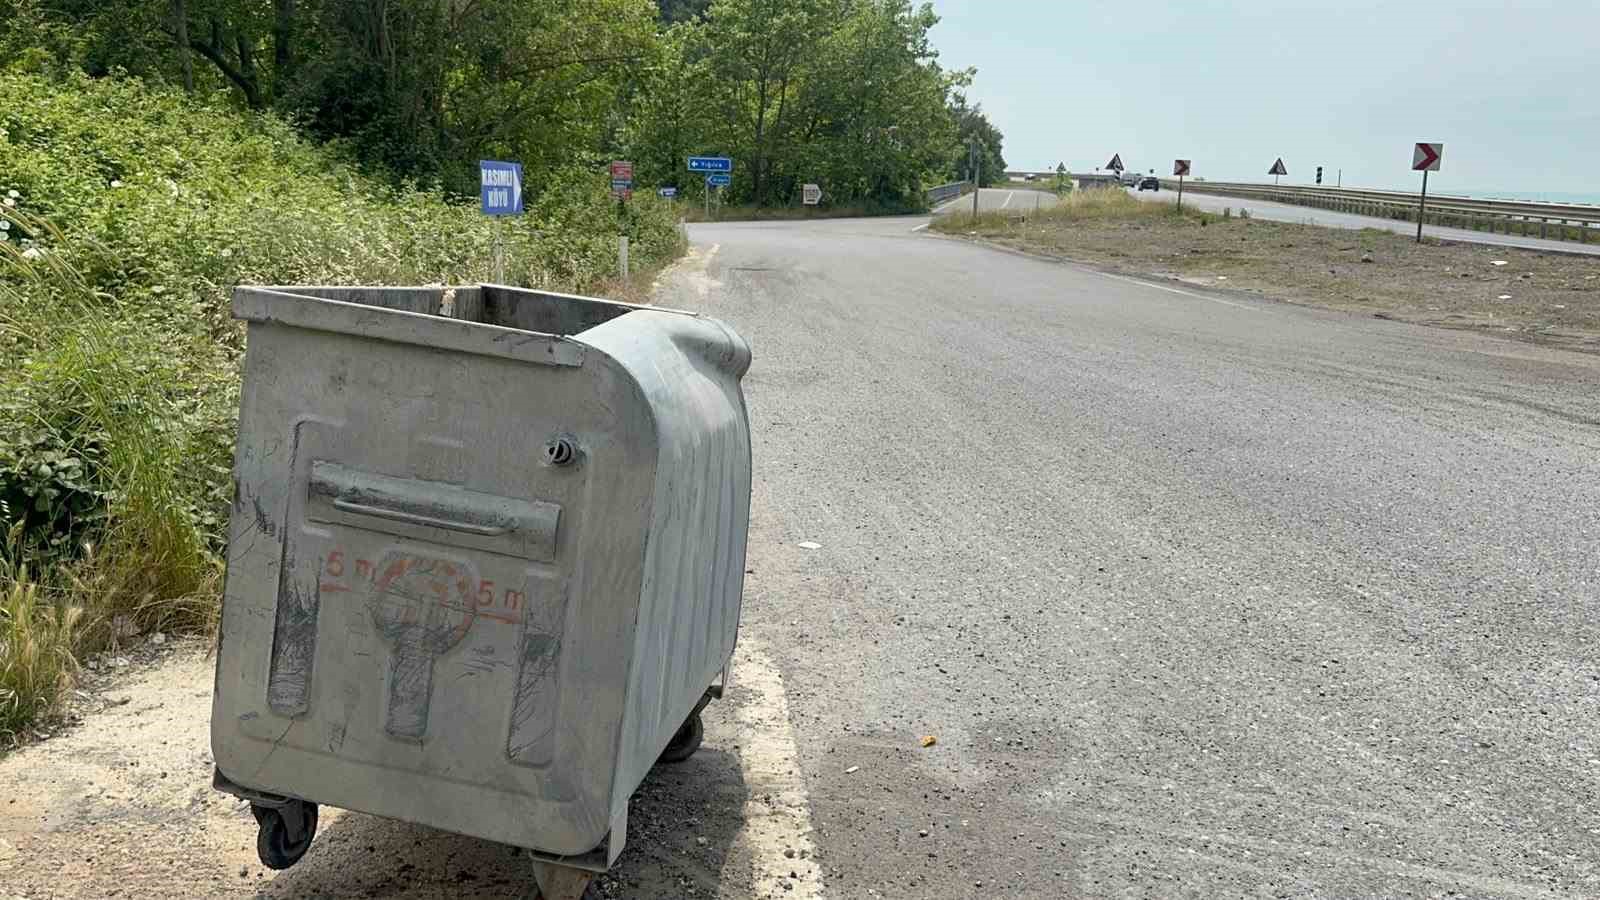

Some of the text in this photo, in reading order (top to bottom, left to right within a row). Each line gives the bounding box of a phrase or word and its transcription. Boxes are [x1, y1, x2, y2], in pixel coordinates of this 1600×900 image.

[487, 188, 508, 208] KÖYÜ
[479, 580, 524, 611] 5 m
